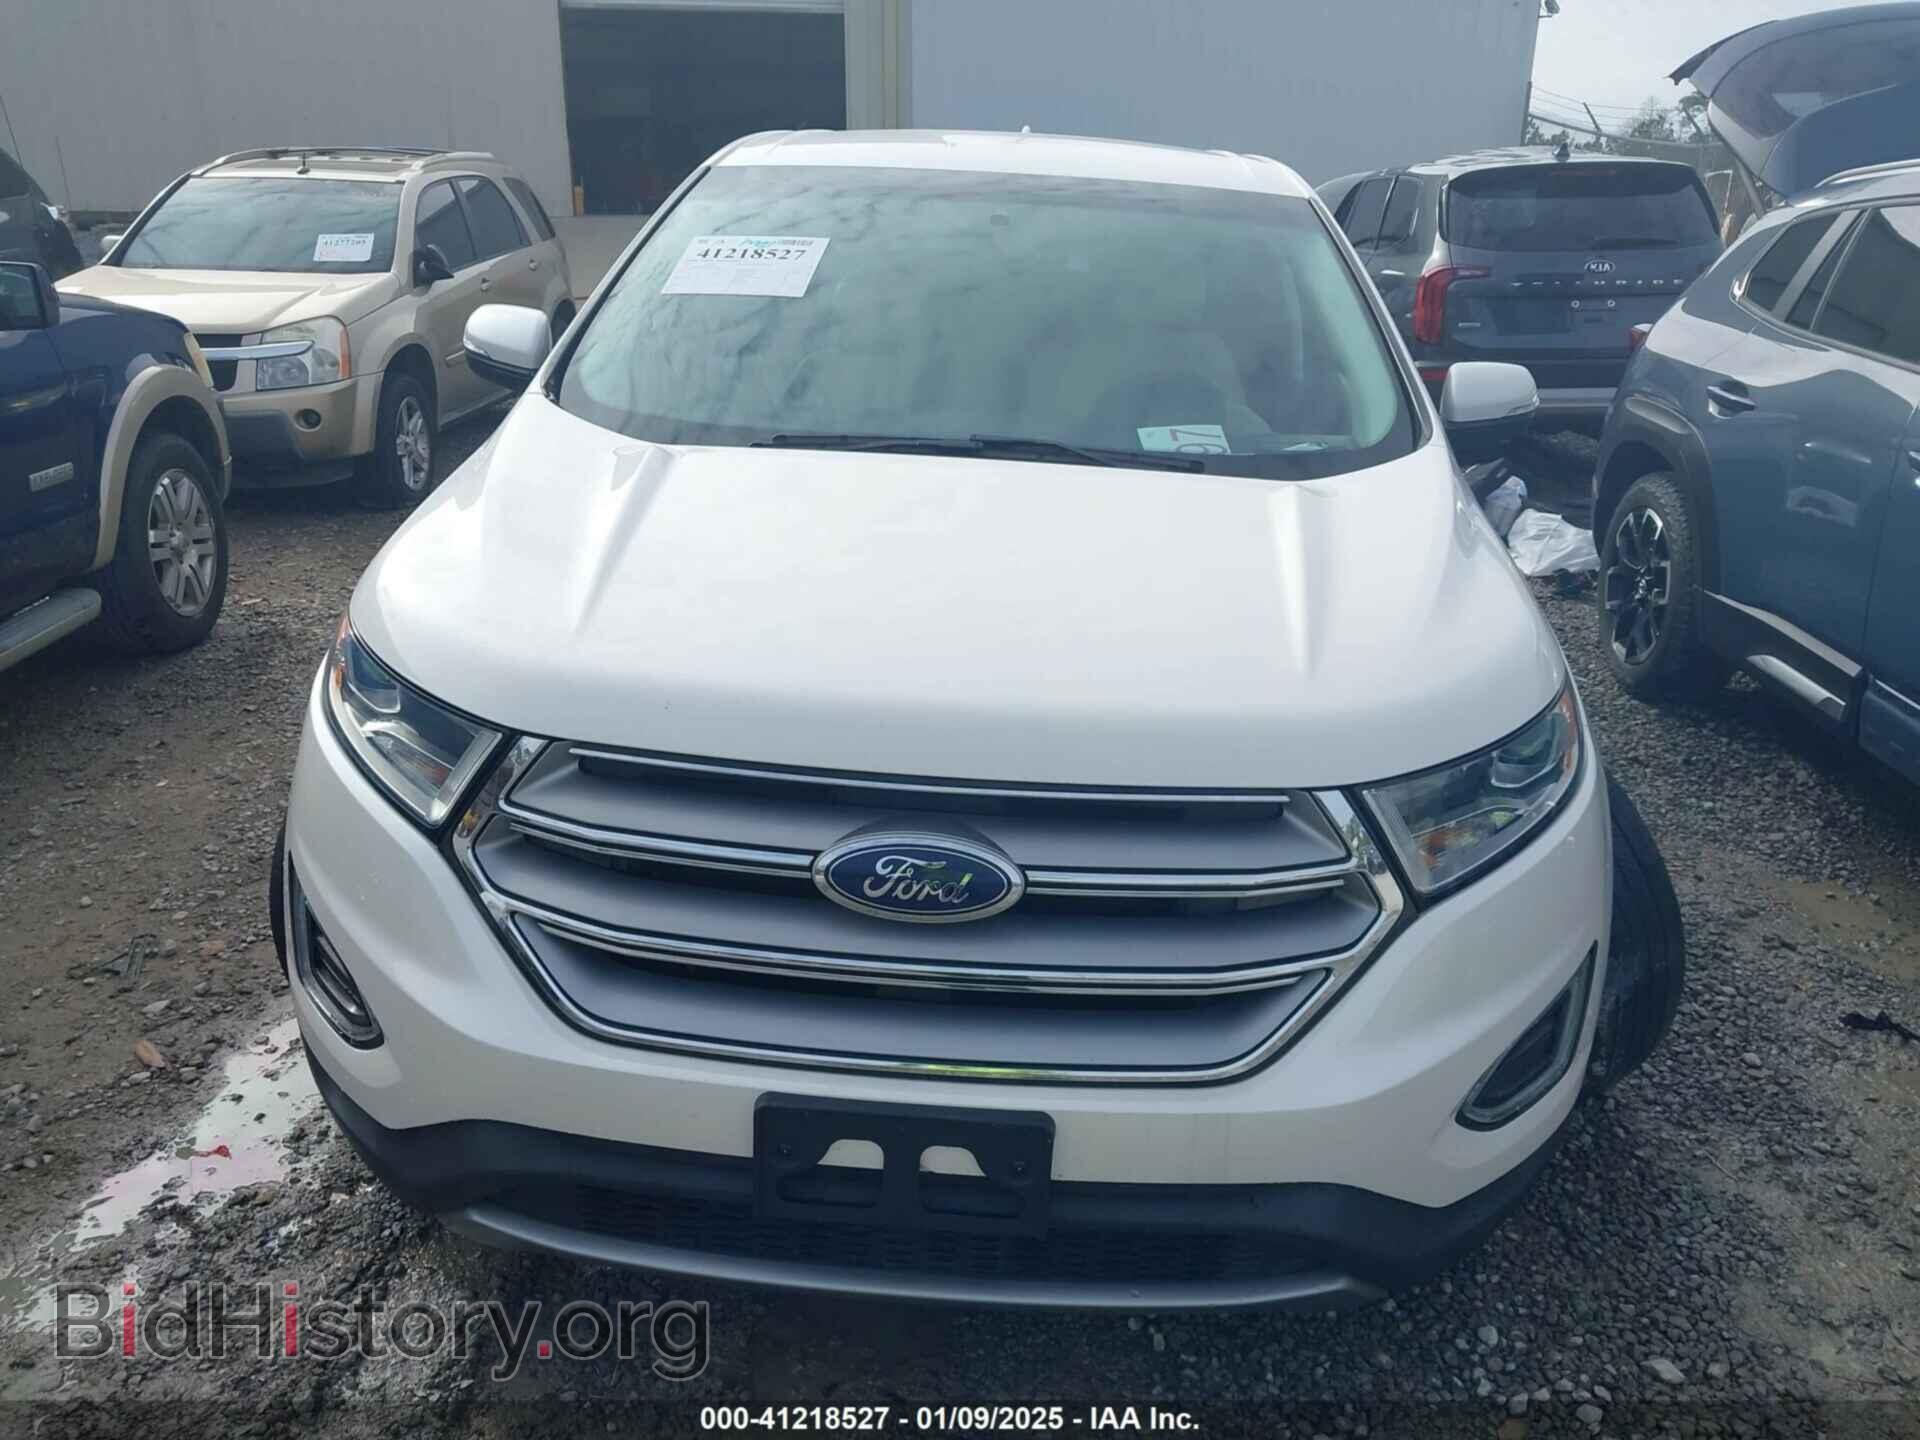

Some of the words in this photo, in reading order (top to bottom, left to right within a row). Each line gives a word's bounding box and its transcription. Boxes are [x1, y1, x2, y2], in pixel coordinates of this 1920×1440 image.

[697, 247, 808, 261] 41218527
[1588, 262, 1612, 273] KIA
[862, 854, 975, 904] Ford
